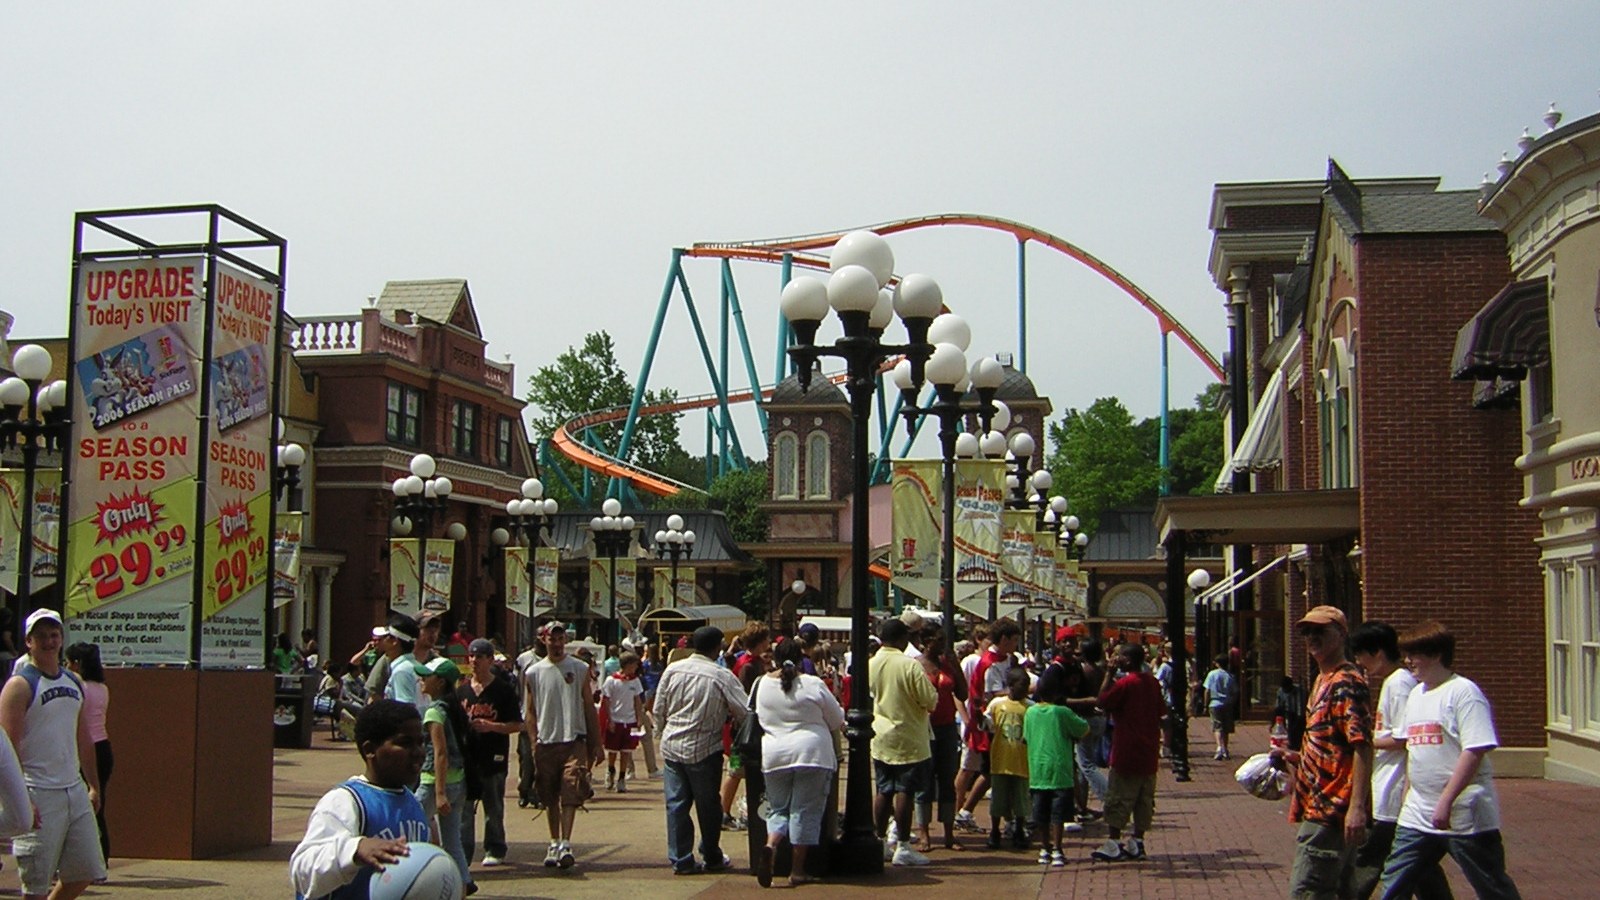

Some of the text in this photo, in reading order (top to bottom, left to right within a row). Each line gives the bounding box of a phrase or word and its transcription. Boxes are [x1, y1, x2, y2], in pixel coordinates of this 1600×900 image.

[87, 267, 194, 301] UPGRADE
[218, 272, 273, 322] UPGRADE
[87, 301, 191, 330] Today's VISIT
[249, 320, 270, 345] VISIT
[96, 380, 191, 426] 2006 SEASON PASS
[121, 421, 148, 431] to a
[80, 436, 187, 458] SEASON
[210, 441, 266, 471] SEASON
[100, 460, 166, 481] PASS
[221, 466, 256, 492] PASS
[103, 500, 152, 532] Only
[222, 509, 248, 537] Only
[84, 623, 102, 631] Park
[125, 623, 148, 632] Guest
[150, 623, 186, 632] Relations
[111, 611, 135, 621] Shops
[136, 611, 180, 622] throughout
[102, 635, 115, 643] the
[117, 635, 138, 643] Front
